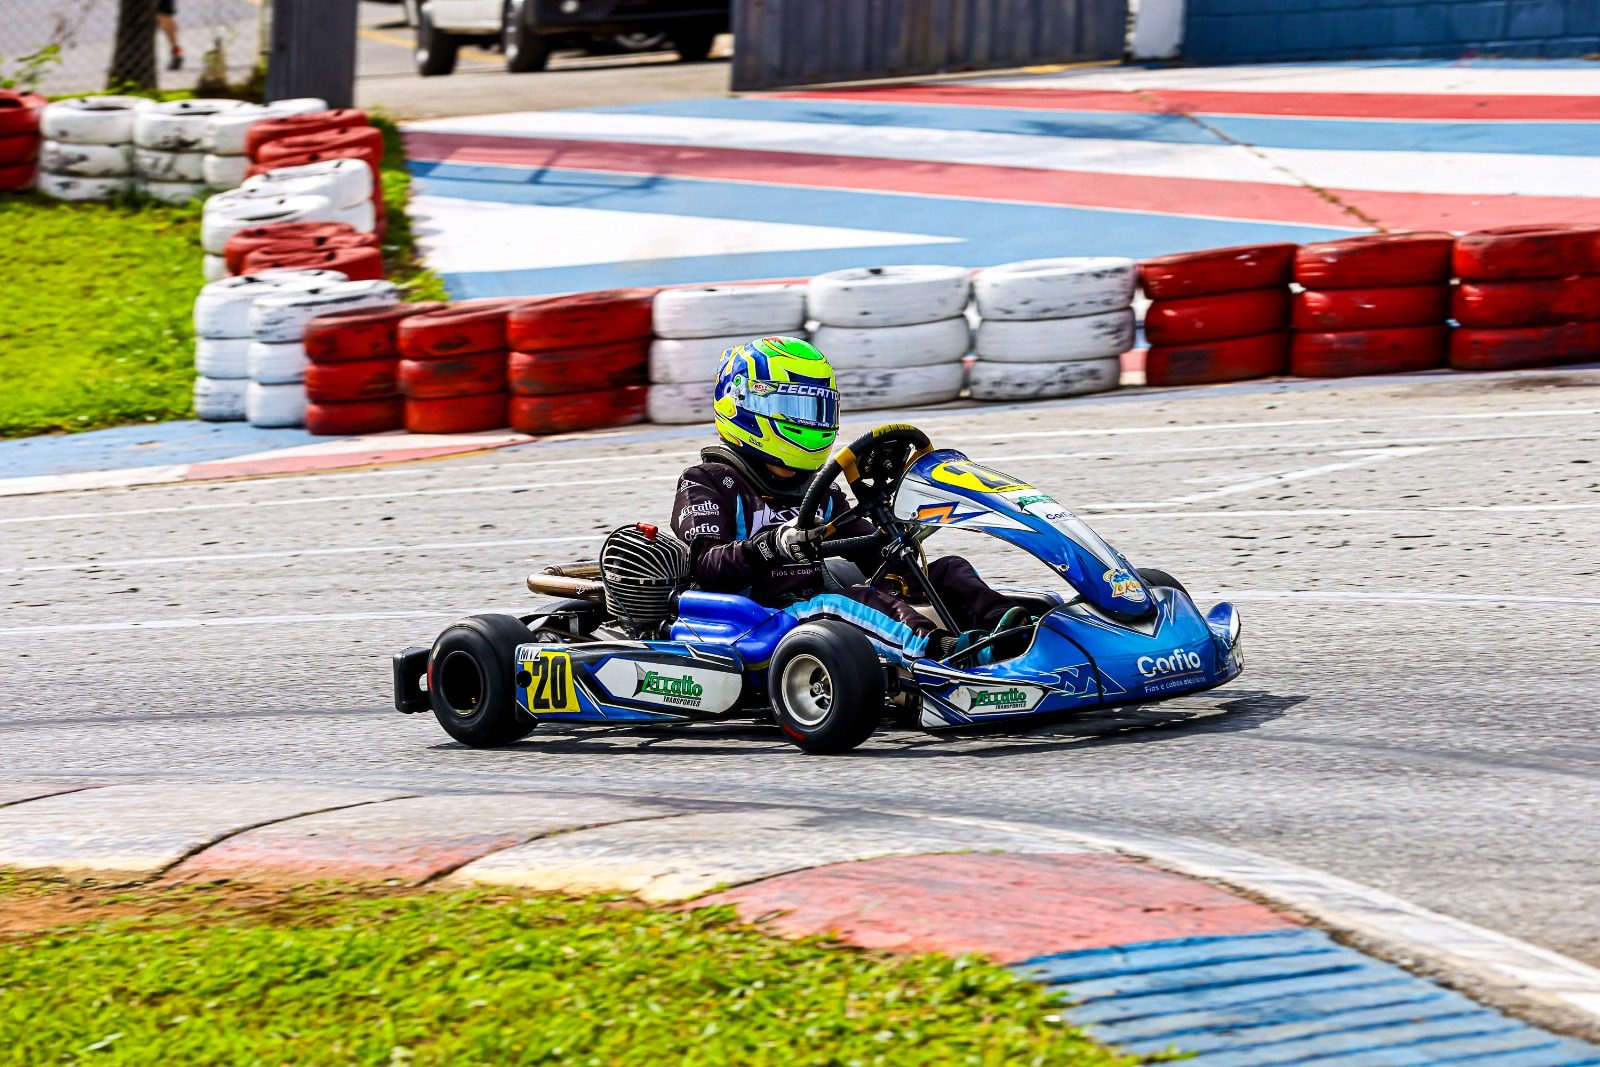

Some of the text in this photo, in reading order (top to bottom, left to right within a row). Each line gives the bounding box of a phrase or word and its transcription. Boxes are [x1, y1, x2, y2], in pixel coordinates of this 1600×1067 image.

[684, 523, 719, 540] Corfio
[760, 541, 774, 559] OMP
[771, 569, 788, 577] Fios
[1137, 649, 1201, 677] Corfio
[532, 656, 568, 710] 20
[1165, 680, 1184, 689] cabos
[663, 696, 701, 707] TRANSPORTES
